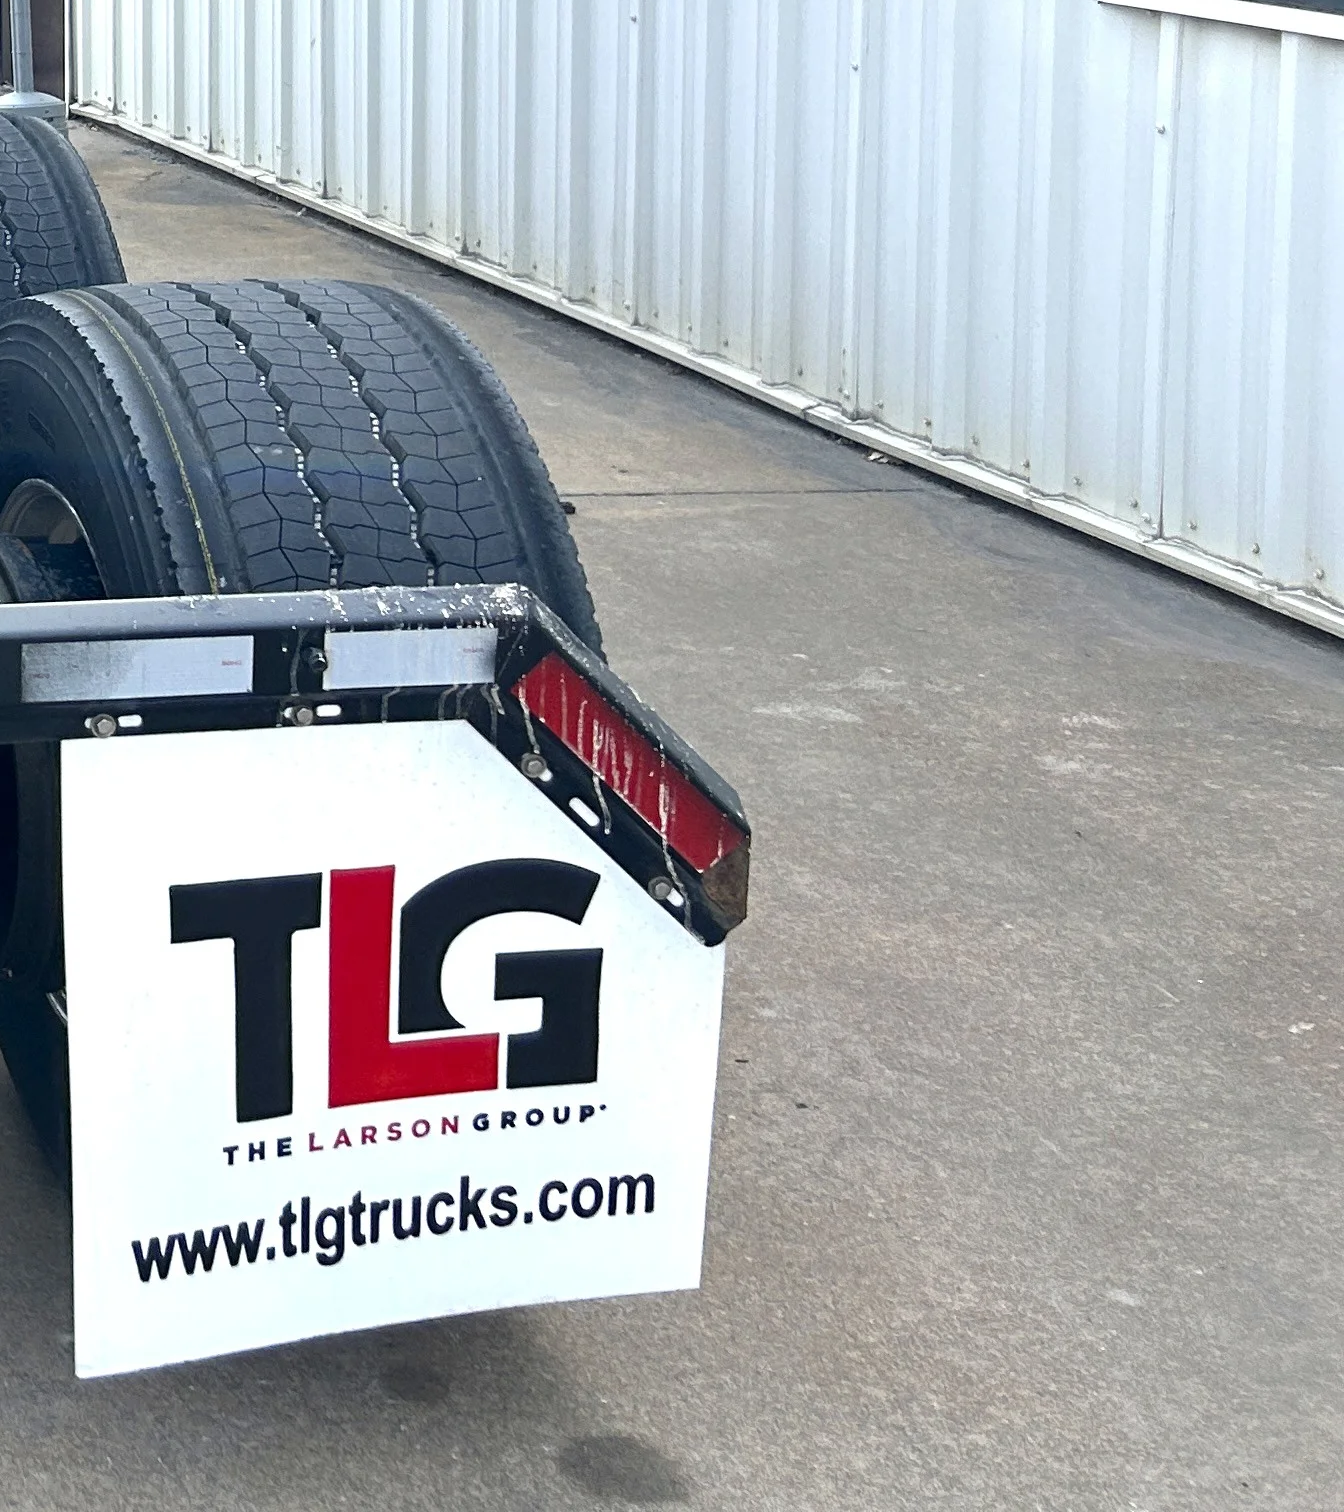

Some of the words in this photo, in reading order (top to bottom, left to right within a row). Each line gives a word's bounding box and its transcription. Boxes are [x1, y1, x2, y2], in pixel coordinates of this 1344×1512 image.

[169, 857, 604, 1124] TLG
[223, 1136, 293, 1166] THE
[308, 1115, 460, 1153] LARSON
[132, 1172, 656, 1283] www.tlgtrucks.com
